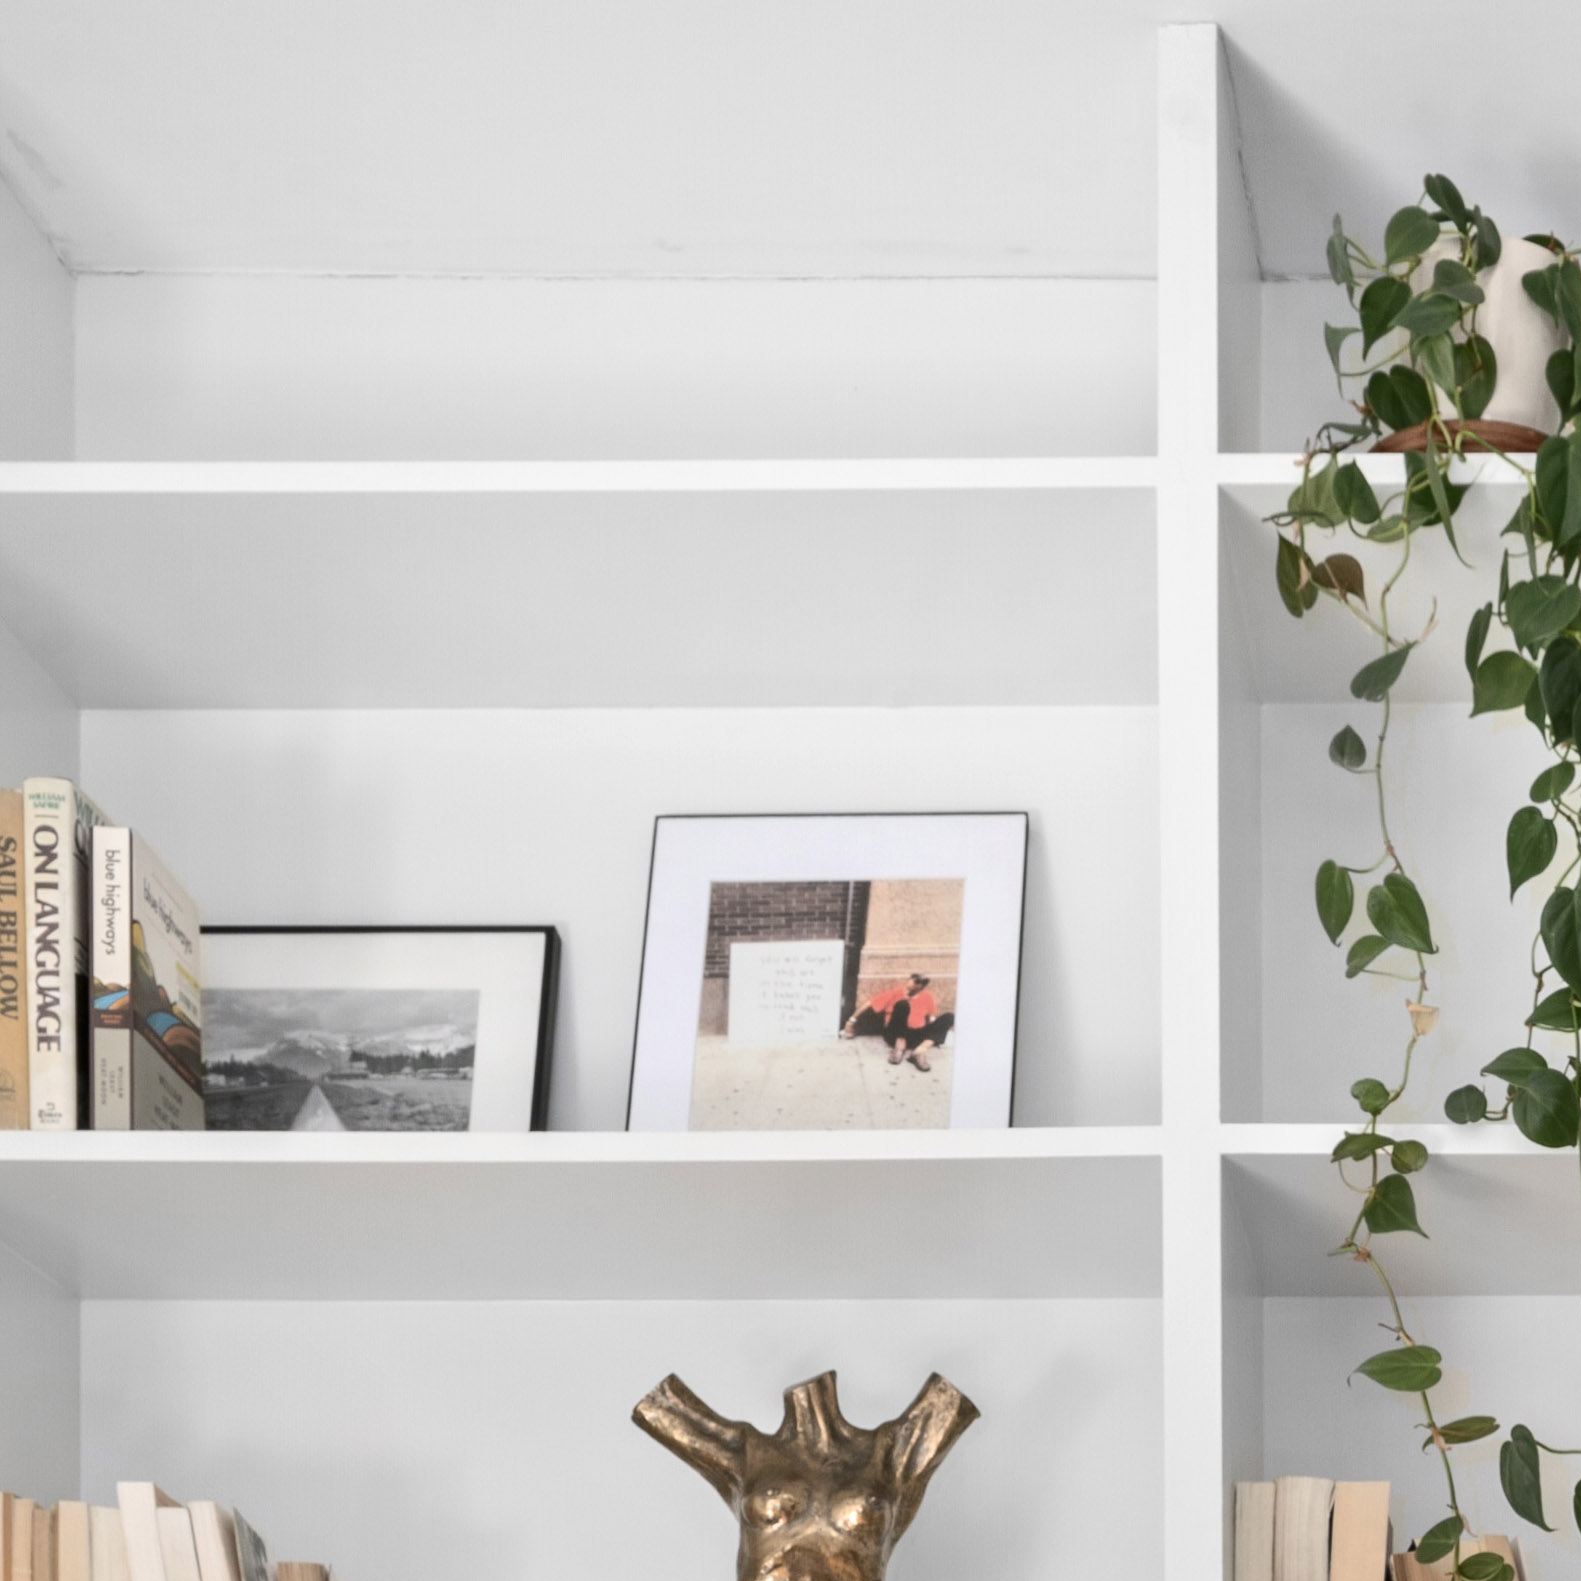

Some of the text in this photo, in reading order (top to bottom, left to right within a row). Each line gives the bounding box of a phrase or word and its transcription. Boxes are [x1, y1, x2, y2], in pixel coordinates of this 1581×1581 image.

[32, 825, 61, 1052] ON LANGUAGE
[101, 850, 121, 955] blue highways
